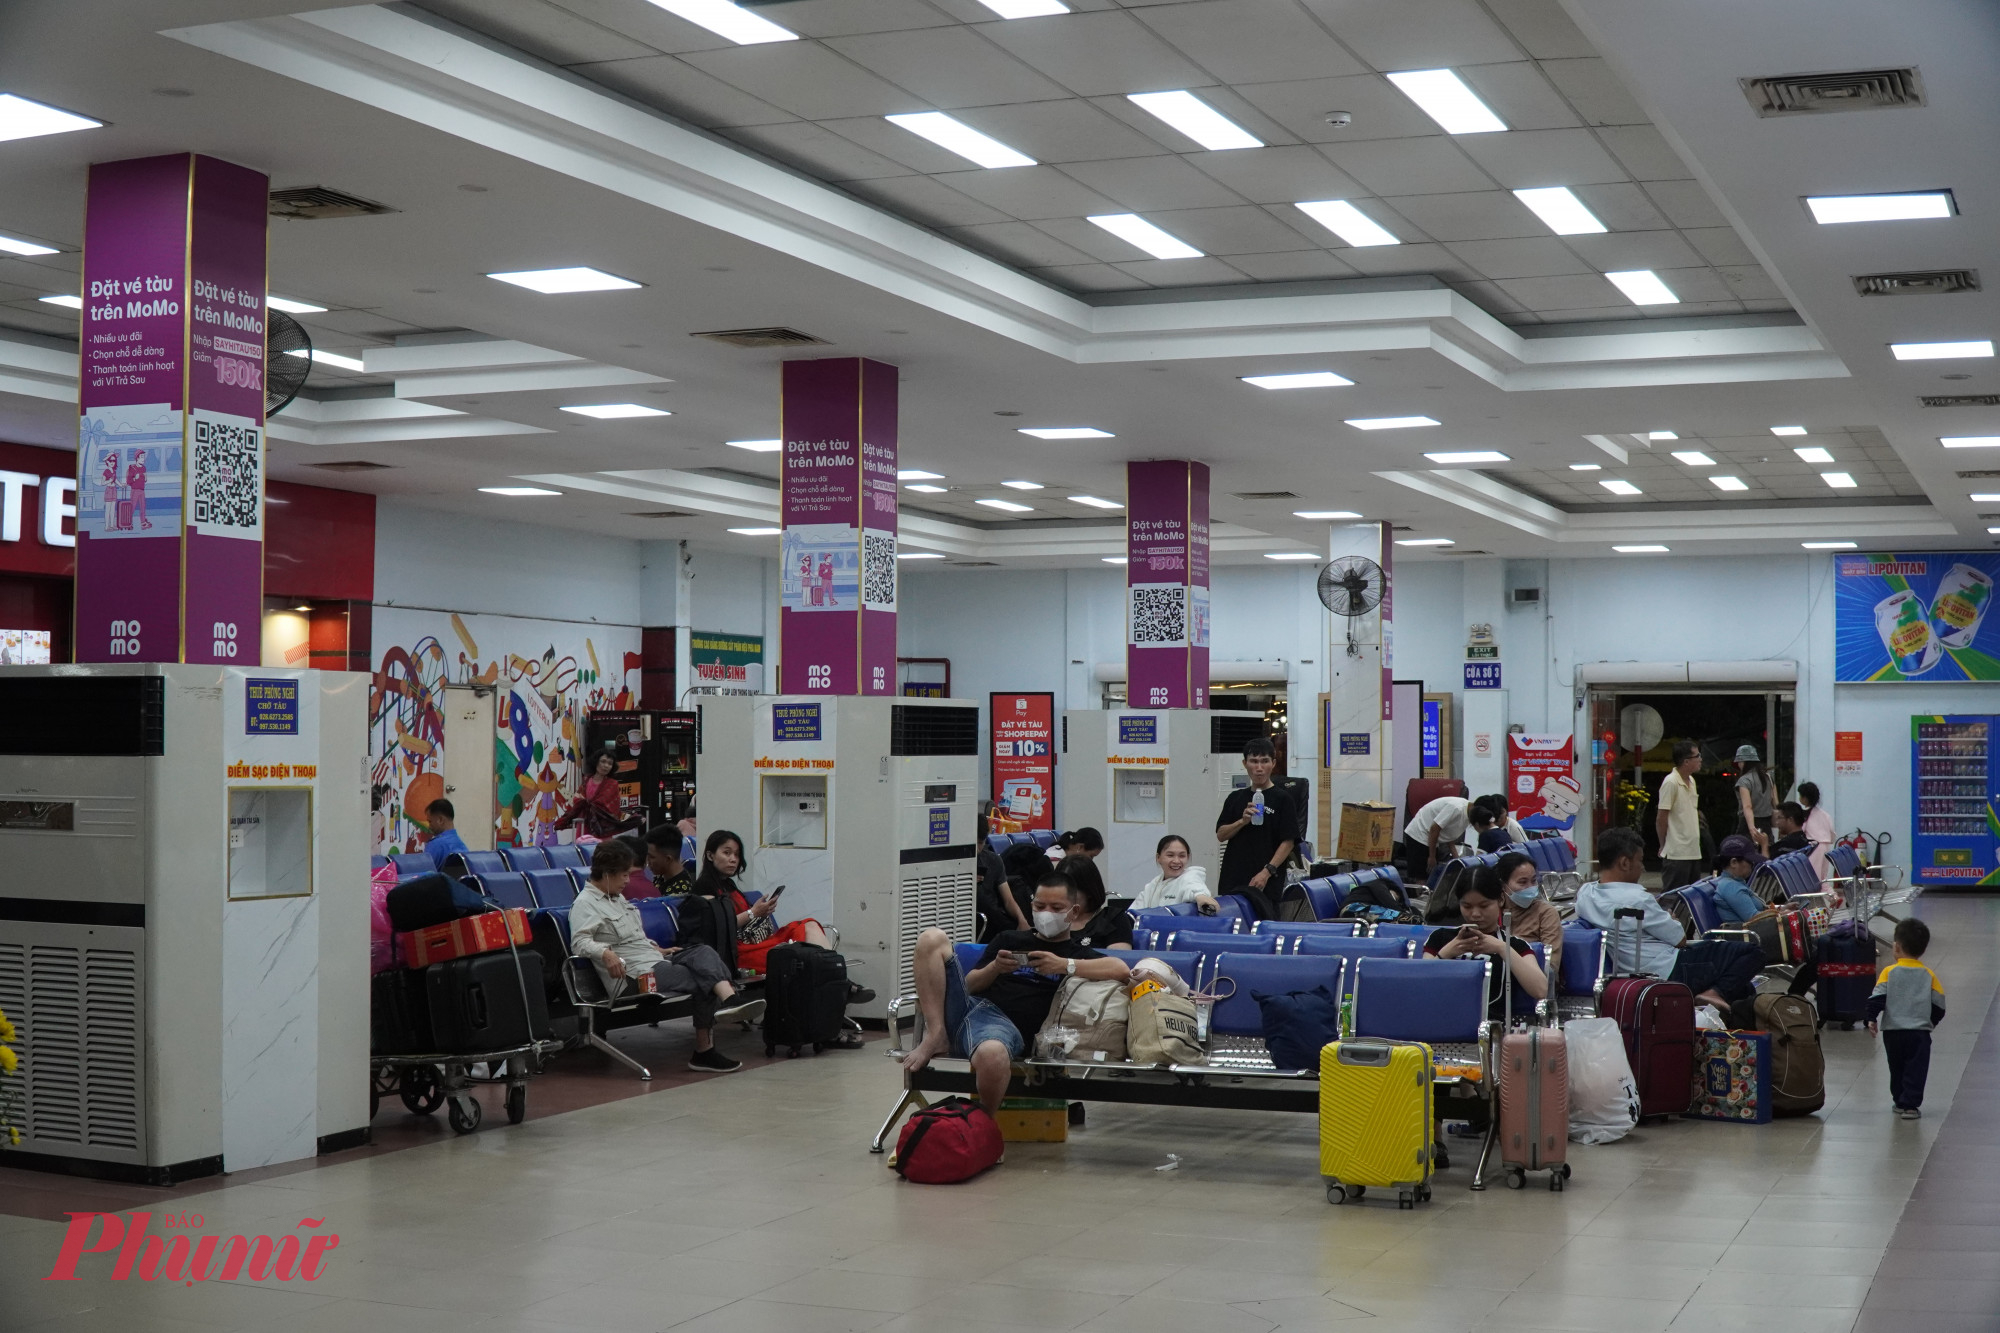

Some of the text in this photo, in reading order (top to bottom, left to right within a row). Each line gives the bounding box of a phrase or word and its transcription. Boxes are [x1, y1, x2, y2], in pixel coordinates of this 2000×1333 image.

[91, 275, 172, 300] Đặt vé tàu
[194, 279, 258, 309] Đặt vé tàu
[91, 300, 178, 321] trên MoMo
[194, 305, 262, 334] trên MoMo
[93, 332, 142, 344] Nhiều ưu đãi
[193, 334, 261, 357] Nhập SAYHITAU150
[93, 346, 164, 360] Chọn chỗ dễ dàng
[93, 361, 174, 374] Thanh toán linh hoạt
[193, 351, 261, 390] Giảm 150k
[92, 376, 104, 387] với
[116, 374, 127, 384] Trả
[788, 439, 850, 454] Đặt vé tàu
[863, 443, 894, 459] Đặt vé tàu
[788, 455, 854, 468] trên MoMo
[863, 460, 896, 476] trên MoMo
[1132, 519, 1181, 532] Đặt vé tàu
[1133, 531, 1184, 541] trên MoMo
[1148, 556, 1184, 570] 150k
[1868, 562, 1926, 576] LIPOVITAN
[1942, 598, 1975, 619] LIPOVITAN
[111, 620, 140, 636] mo
[213, 622, 237, 639] mo
[1893, 625, 1926, 645] LIPOVITAN
[110, 638, 140, 655] mo
[213, 640, 237, 657] mo
[698, 657, 746, 680] TUYỂN SINH
[808, 665, 831, 676] mo
[874, 667, 884, 678] mo
[1467, 665, 1499, 678] CỬA SỐ 3
[808, 677, 831, 688] mo
[874, 679, 884, 690] mo
[249, 684, 263, 699] THUÊ
[264, 684, 281, 699] PHÒNG
[274, 701, 286, 709] TÀU
[1001, 720, 1015, 729] ĐẶT
[1016, 740, 1045, 756] 10%
[754, 756, 834, 769] ĐIỂM SẠC ĐIỆN THOẠI
[1107, 755, 1122, 763] ĐIỂM
[228, 760, 316, 780] ĐIỂM SẠC ĐIỆN THOẠI
[1941, 868, 1984, 877] LIPOVITAN
[1164, 1017, 1185, 1033] HELLO
